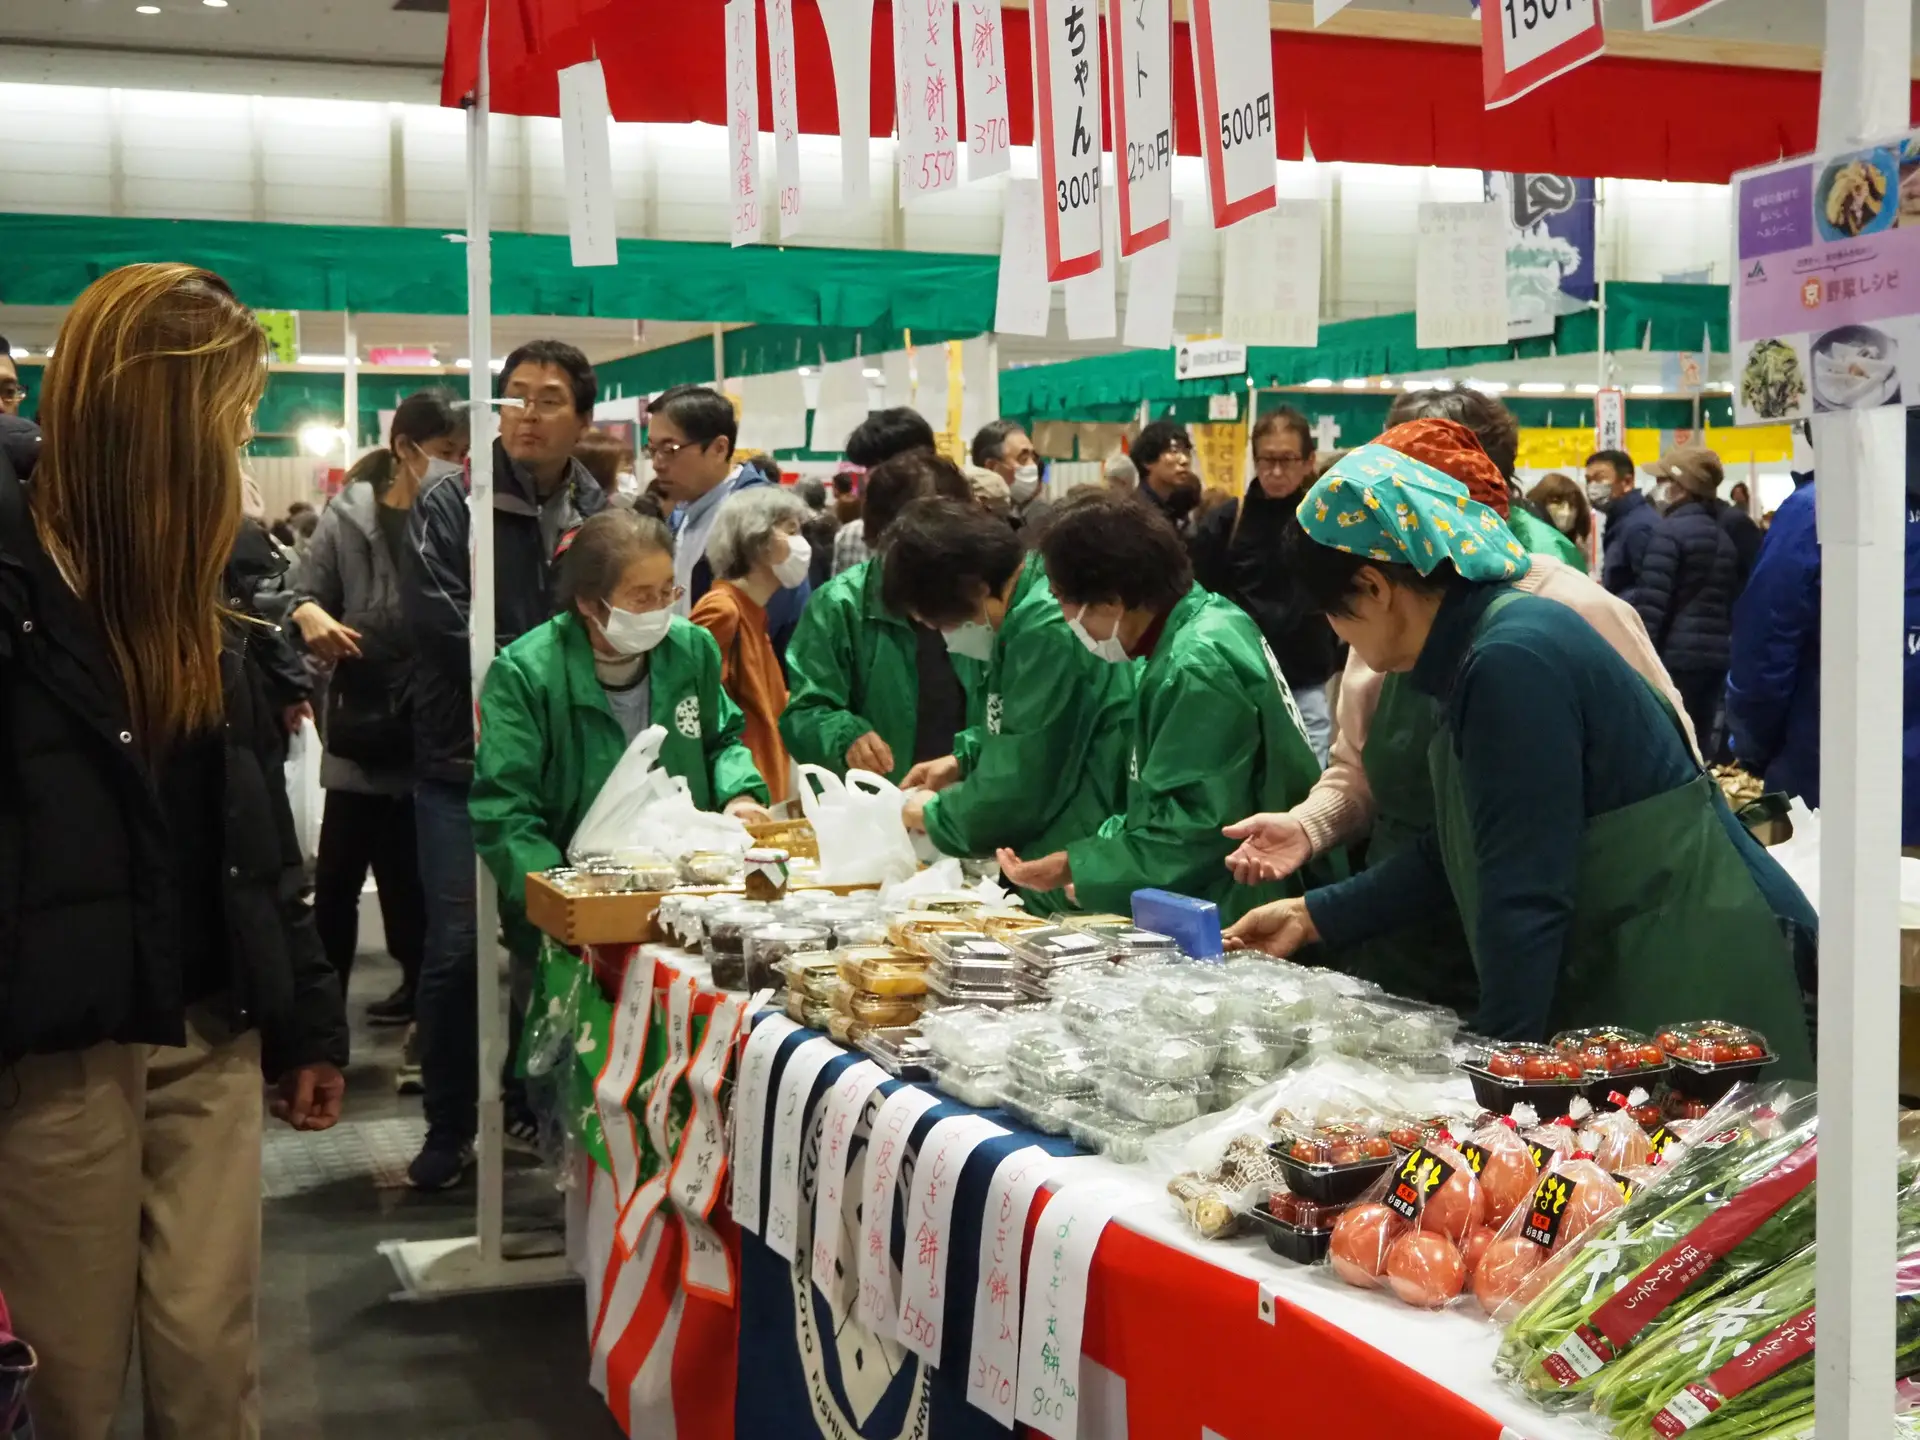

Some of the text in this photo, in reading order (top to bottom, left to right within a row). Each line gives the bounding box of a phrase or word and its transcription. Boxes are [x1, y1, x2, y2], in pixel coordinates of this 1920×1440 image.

[1065, 5, 1091, 157] ちゃん
[974, 118, 1007, 154] 370
[1221, 92, 1271, 150] 500円
[918, 151, 954, 189] 550
[1128, 129, 1168, 184] 250円
[736, 202, 757, 233] 350
[781, 187, 799, 215] 450
[1624, 1244, 1700, 1310] ほうれんそう
[903, 1296, 936, 1349] 550
[973, 1353, 1012, 1405] 370
